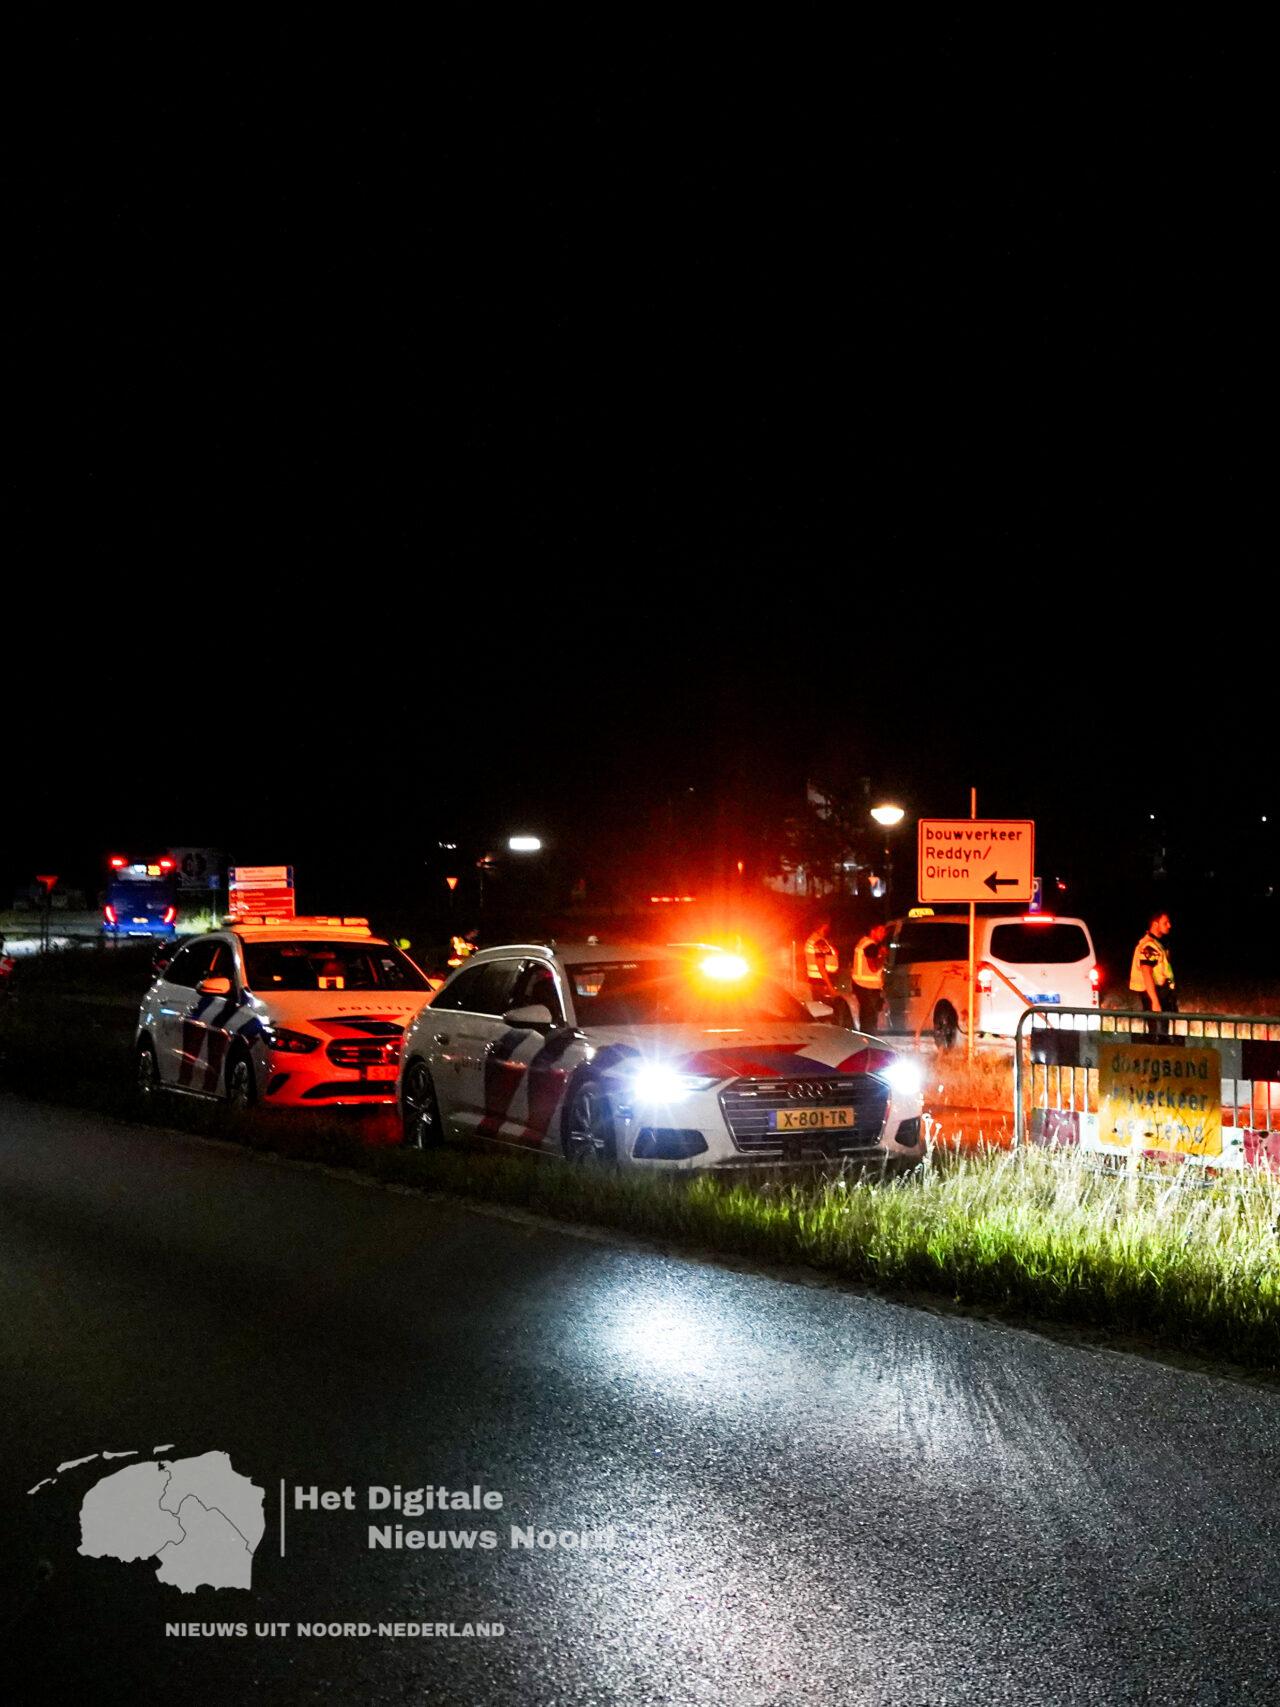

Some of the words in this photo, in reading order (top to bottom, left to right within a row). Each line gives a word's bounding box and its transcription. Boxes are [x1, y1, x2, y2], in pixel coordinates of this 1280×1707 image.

[926, 828, 1023, 840] bouwverkeer
[926, 846, 991, 862] Reddyn/
[926, 866, 969, 878] Qirion
[784, 1111, 847, 1127] X-801-TR
